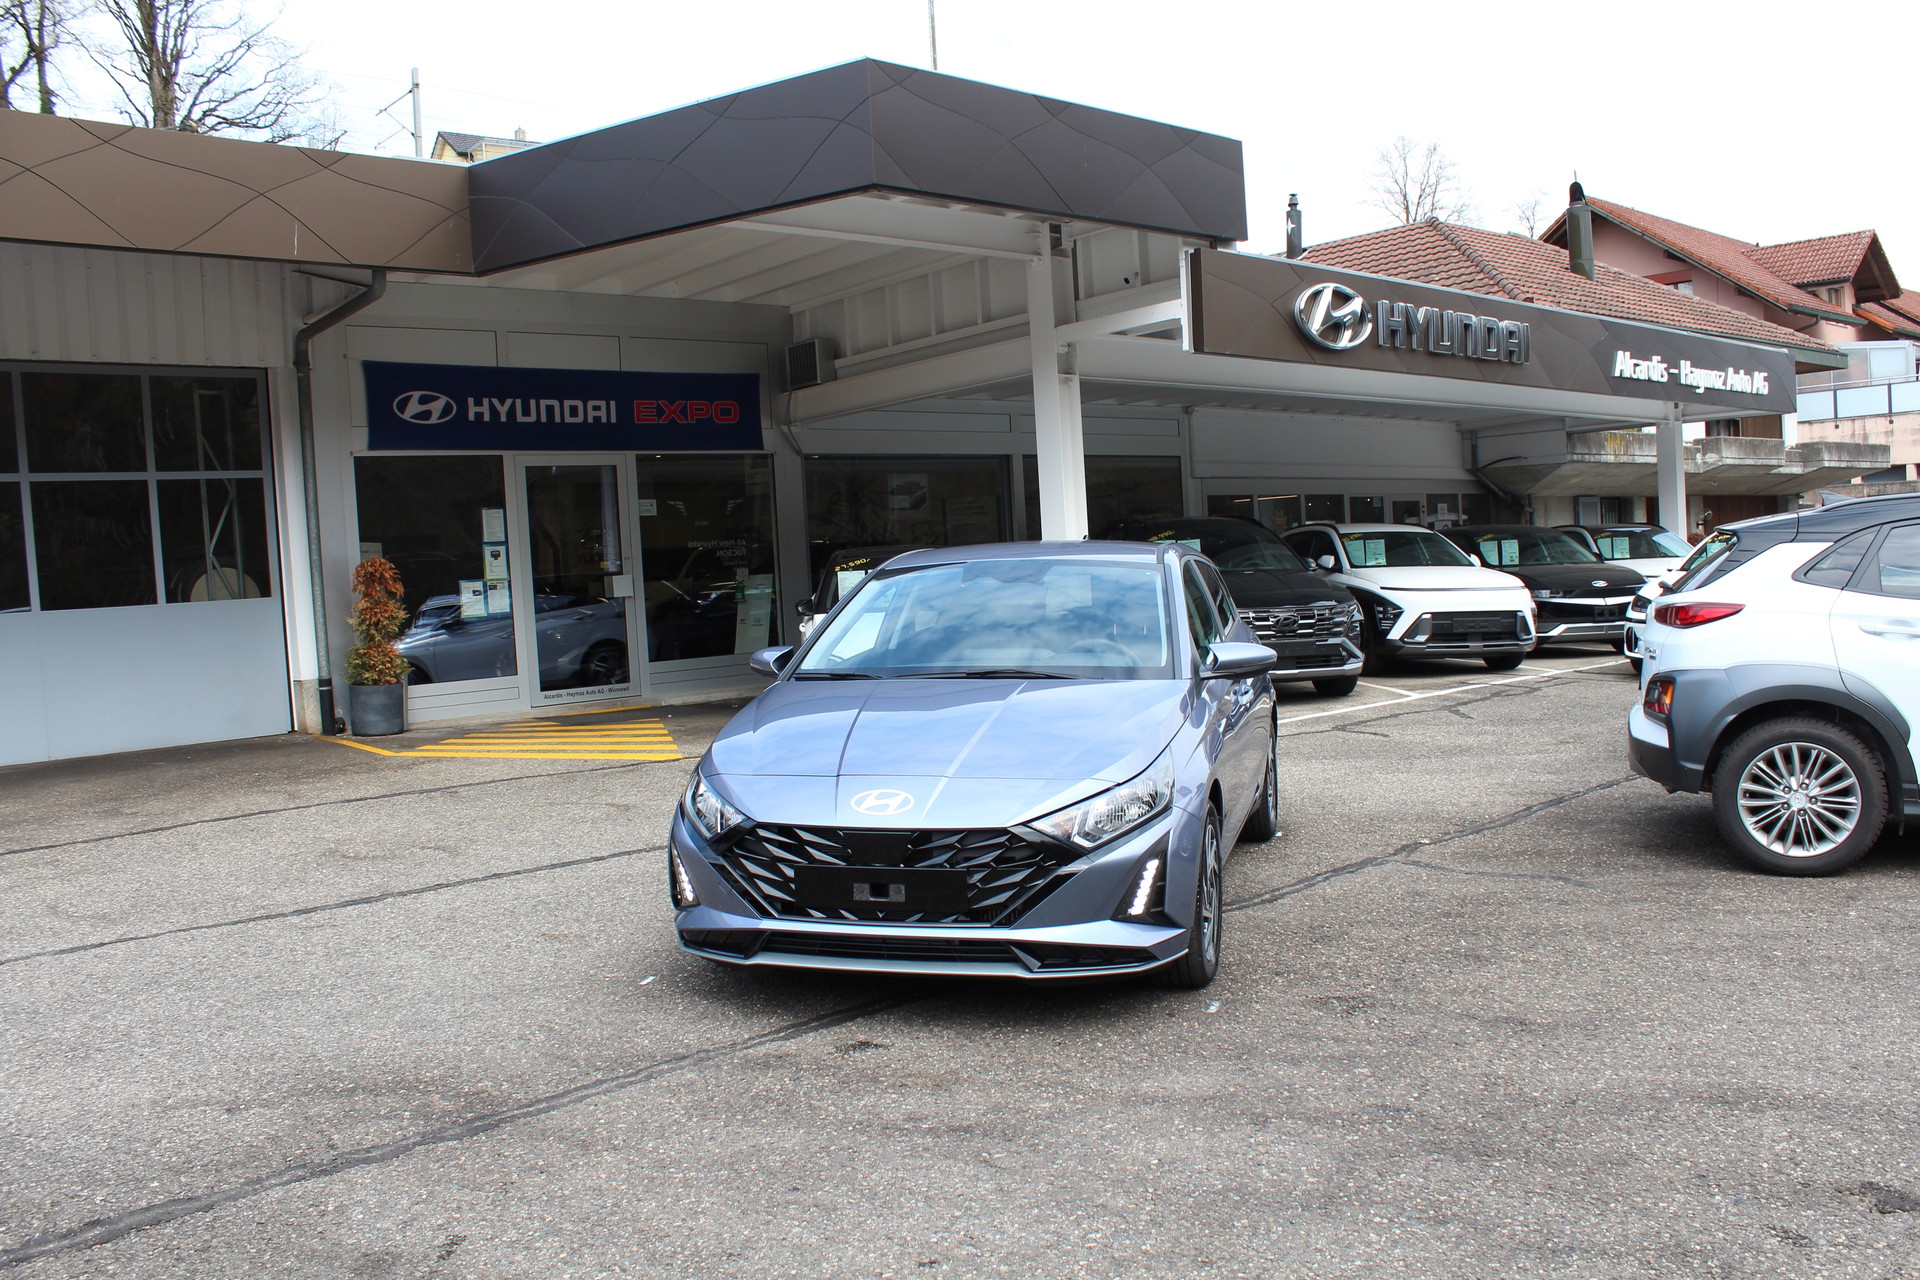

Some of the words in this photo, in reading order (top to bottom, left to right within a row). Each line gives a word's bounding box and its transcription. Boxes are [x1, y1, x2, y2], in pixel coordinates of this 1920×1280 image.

[1377, 300, 1531, 365] HYUNDAI
[1613, 350, 1668, 383] Alcardis
[1679, 360, 1726, 394] Haymoz
[1726, 367, 1751, 394] Auto
[1751, 371, 1769, 396] AG
[467, 397, 616, 423] HYUNDAI
[633, 400, 740, 424] EXPO
